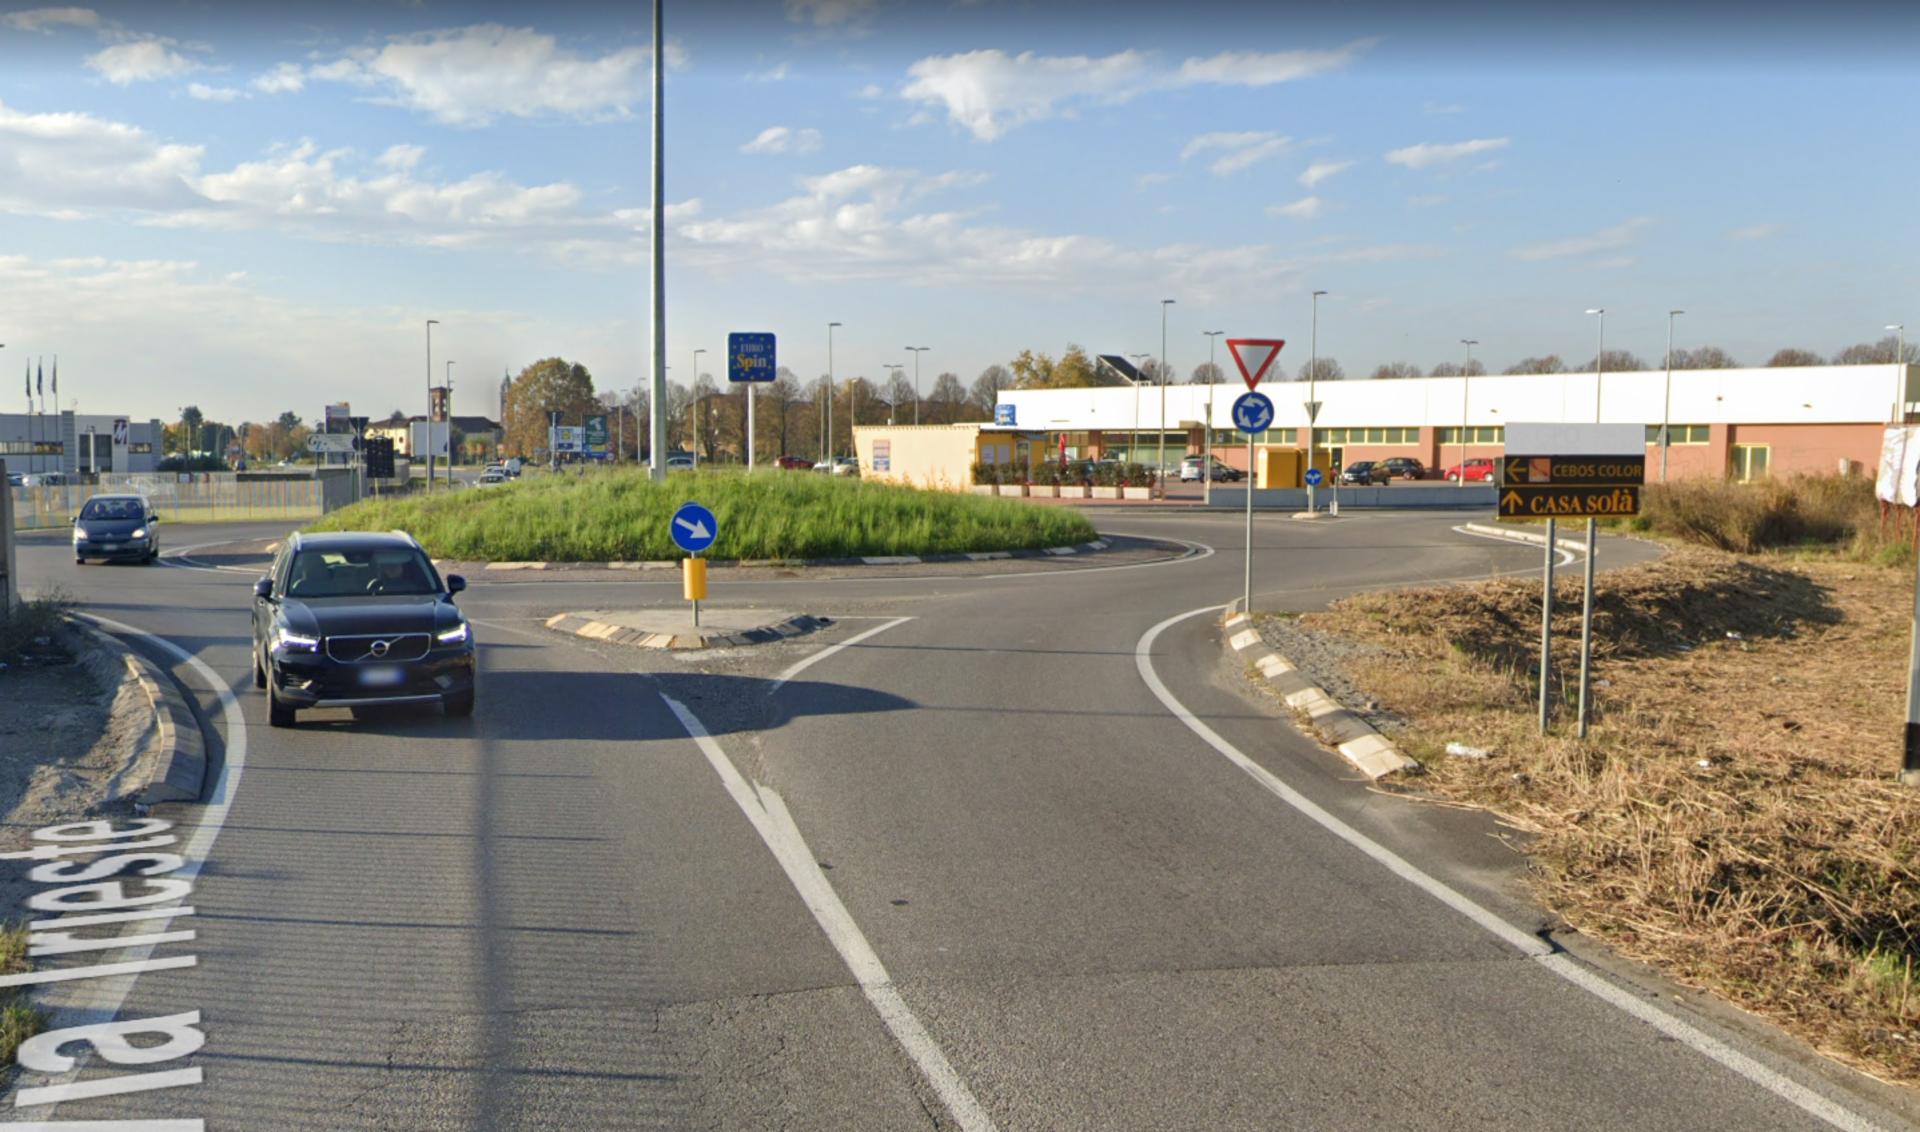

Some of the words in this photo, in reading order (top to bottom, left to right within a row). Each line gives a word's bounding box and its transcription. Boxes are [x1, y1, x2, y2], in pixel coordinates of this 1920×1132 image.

[736, 352, 767, 372] Spin
[1552, 464, 1595, 477] CEBOS
[1597, 464, 1641, 477] COLOR
[1530, 496, 1580, 513] CASA
